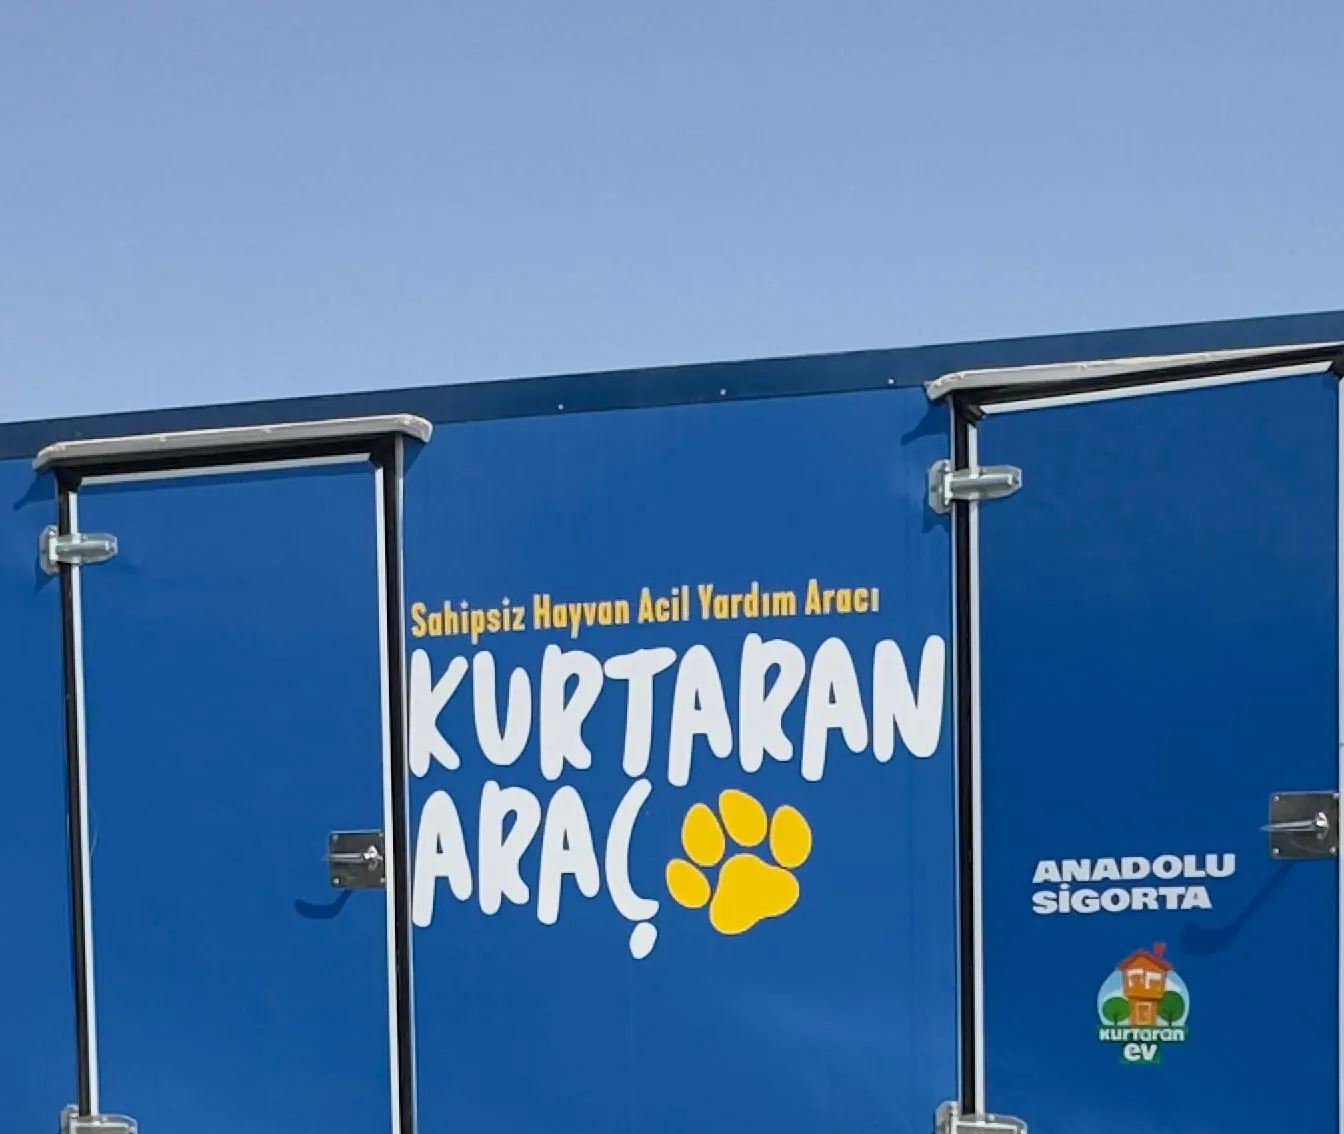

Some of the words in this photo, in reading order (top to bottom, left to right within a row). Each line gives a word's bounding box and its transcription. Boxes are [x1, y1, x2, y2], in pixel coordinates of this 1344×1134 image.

[410, 597, 526, 645] Sahipsiz
[532, 593, 630, 639] Hayvan
[638, 585, 690, 623] Acil
[698, 581, 797, 620] Yardım
[804, 578, 880, 616] Aracı
[409, 633, 946, 787] KURTARAN
[411, 778, 660, 959] ARAÇ
[1032, 853, 1236, 884] ANADOLU
[1032, 882, 1212, 914] SİGORTA
[1099, 1027, 1185, 1042] kurtaran
[1123, 1043, 1157, 1062] ev
